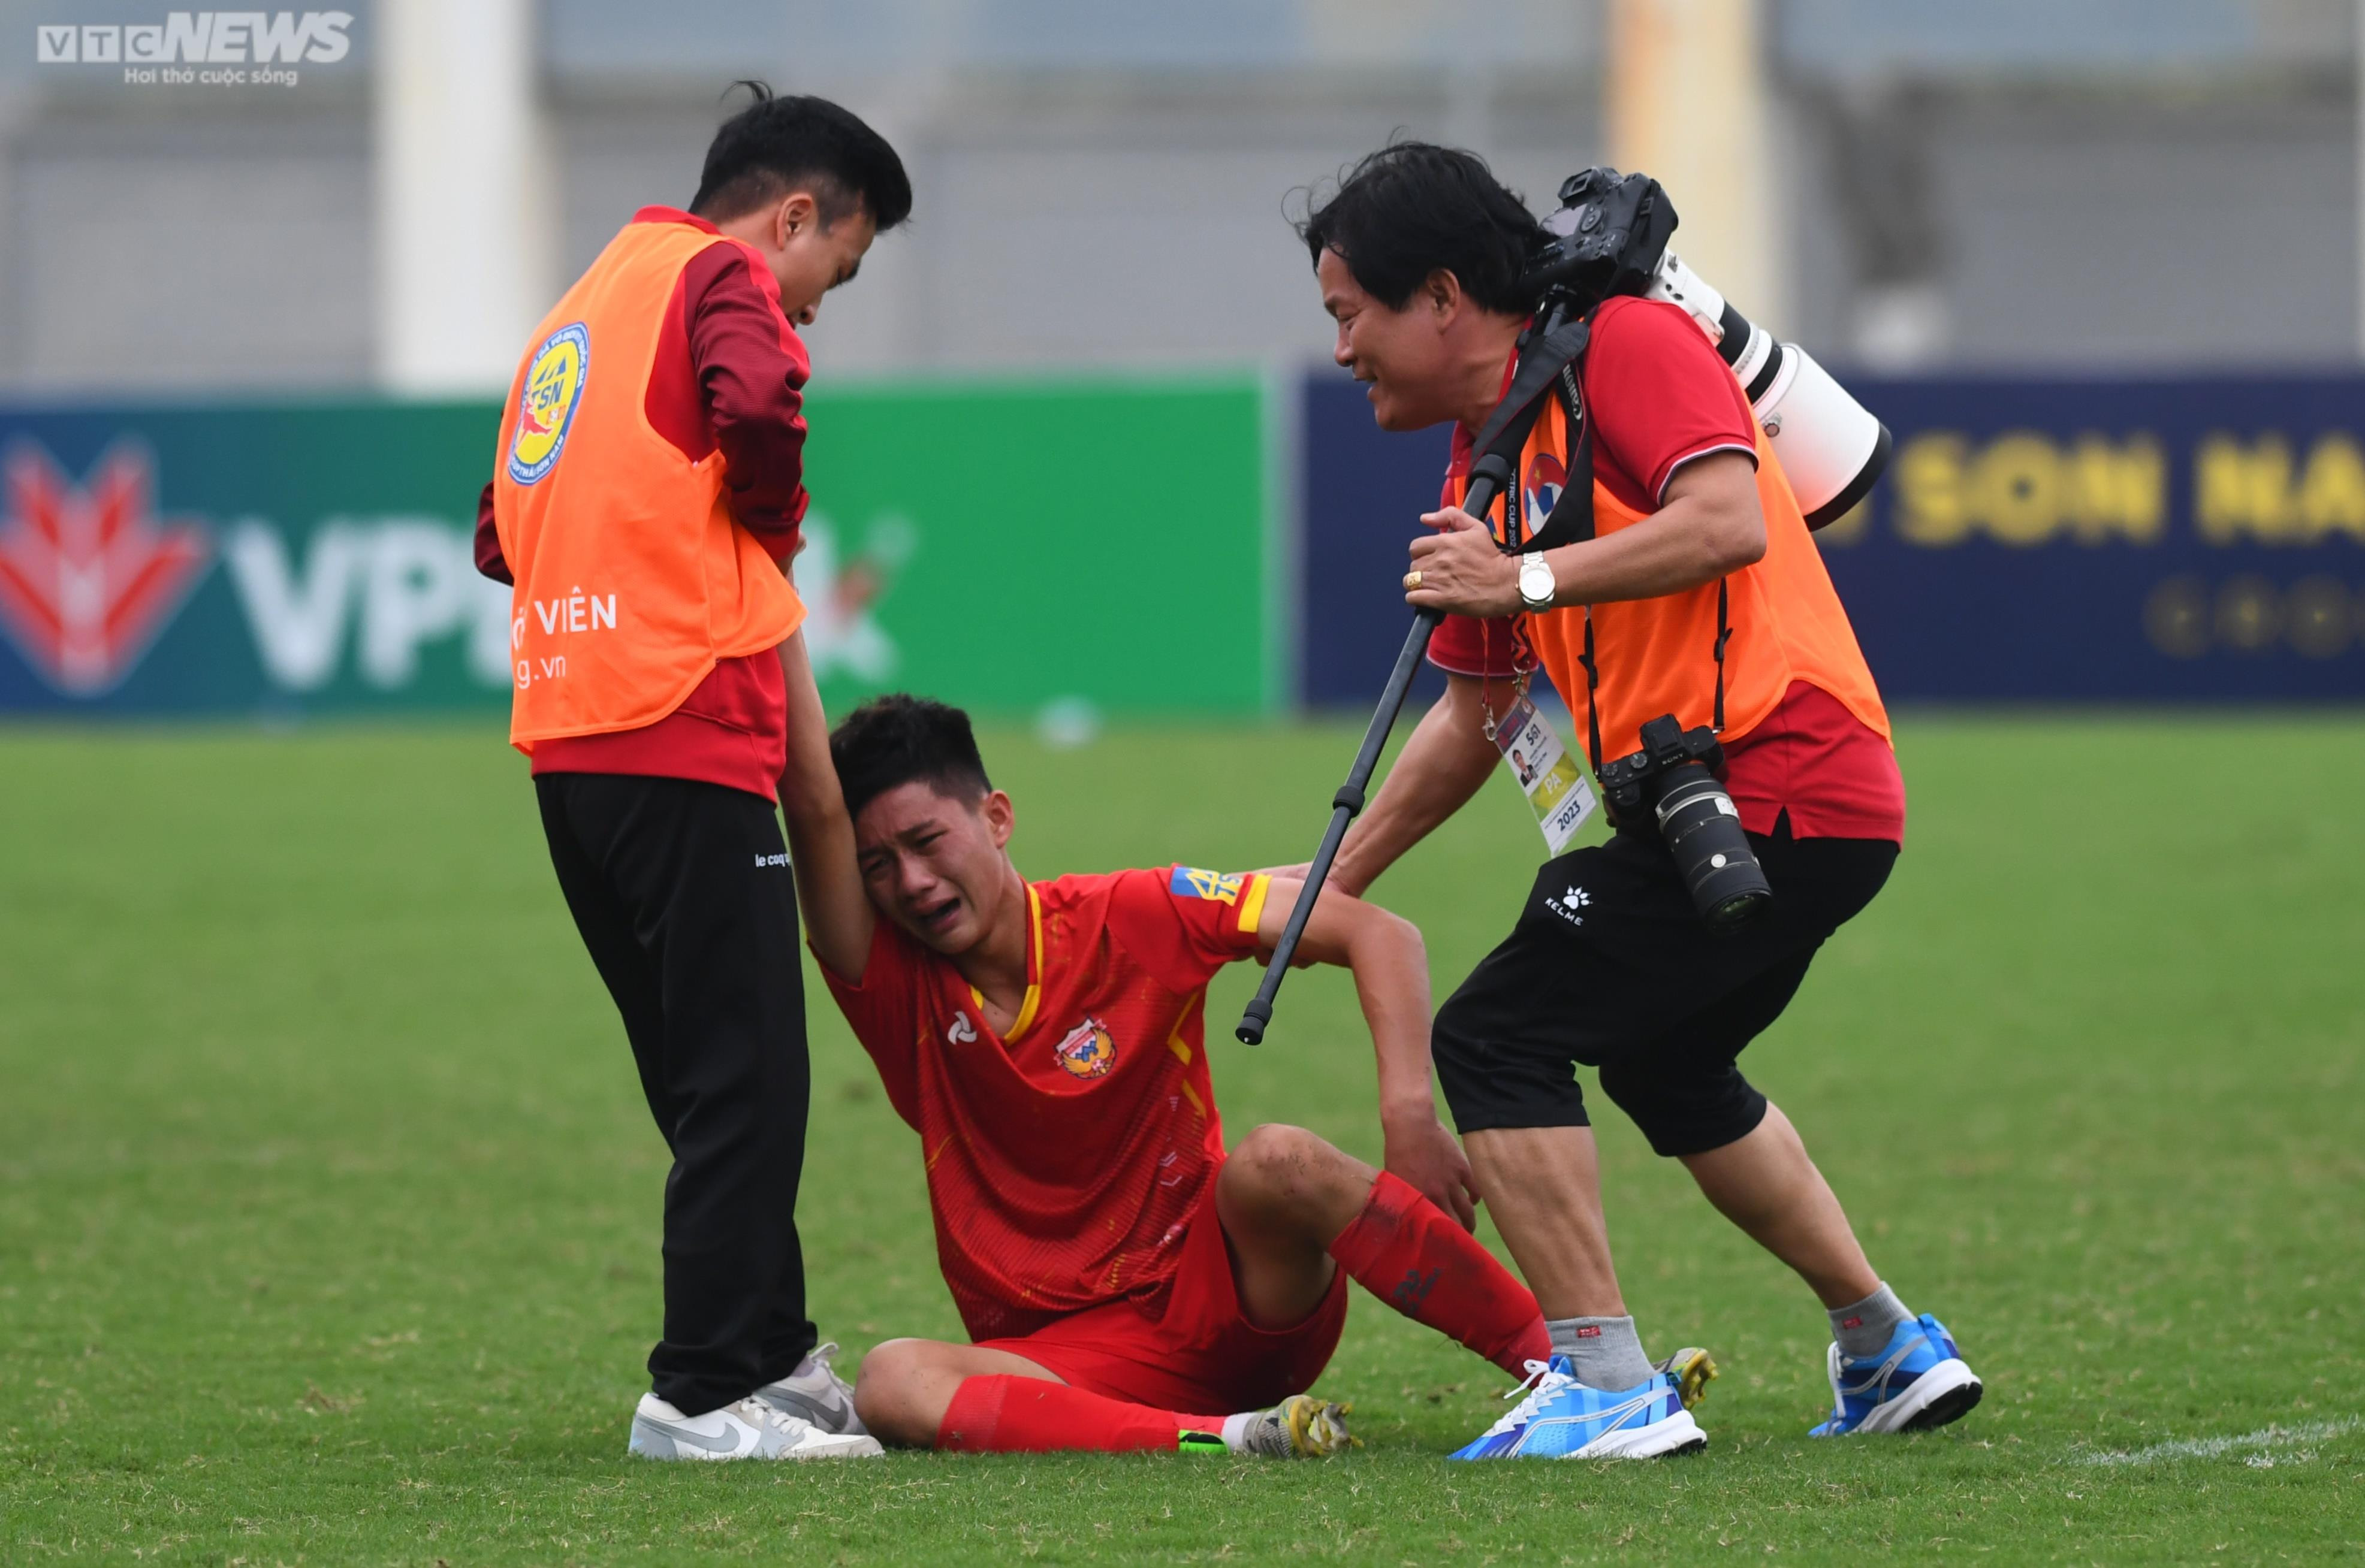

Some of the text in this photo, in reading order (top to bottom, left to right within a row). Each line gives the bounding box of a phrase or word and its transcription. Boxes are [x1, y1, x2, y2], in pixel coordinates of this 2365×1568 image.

[1562, 364, 1582, 420] Canon
[534, 585, 616, 635] VIÊN
[517, 655, 566, 689] g.vn
[1661, 753, 1684, 766] SONY
[1545, 772, 1562, 794] PA
[1557, 799, 1580, 832] 2023
[755, 853, 766, 867] le
[767, 854, 785, 868] coq
[1545, 897, 1584, 926] KELME
